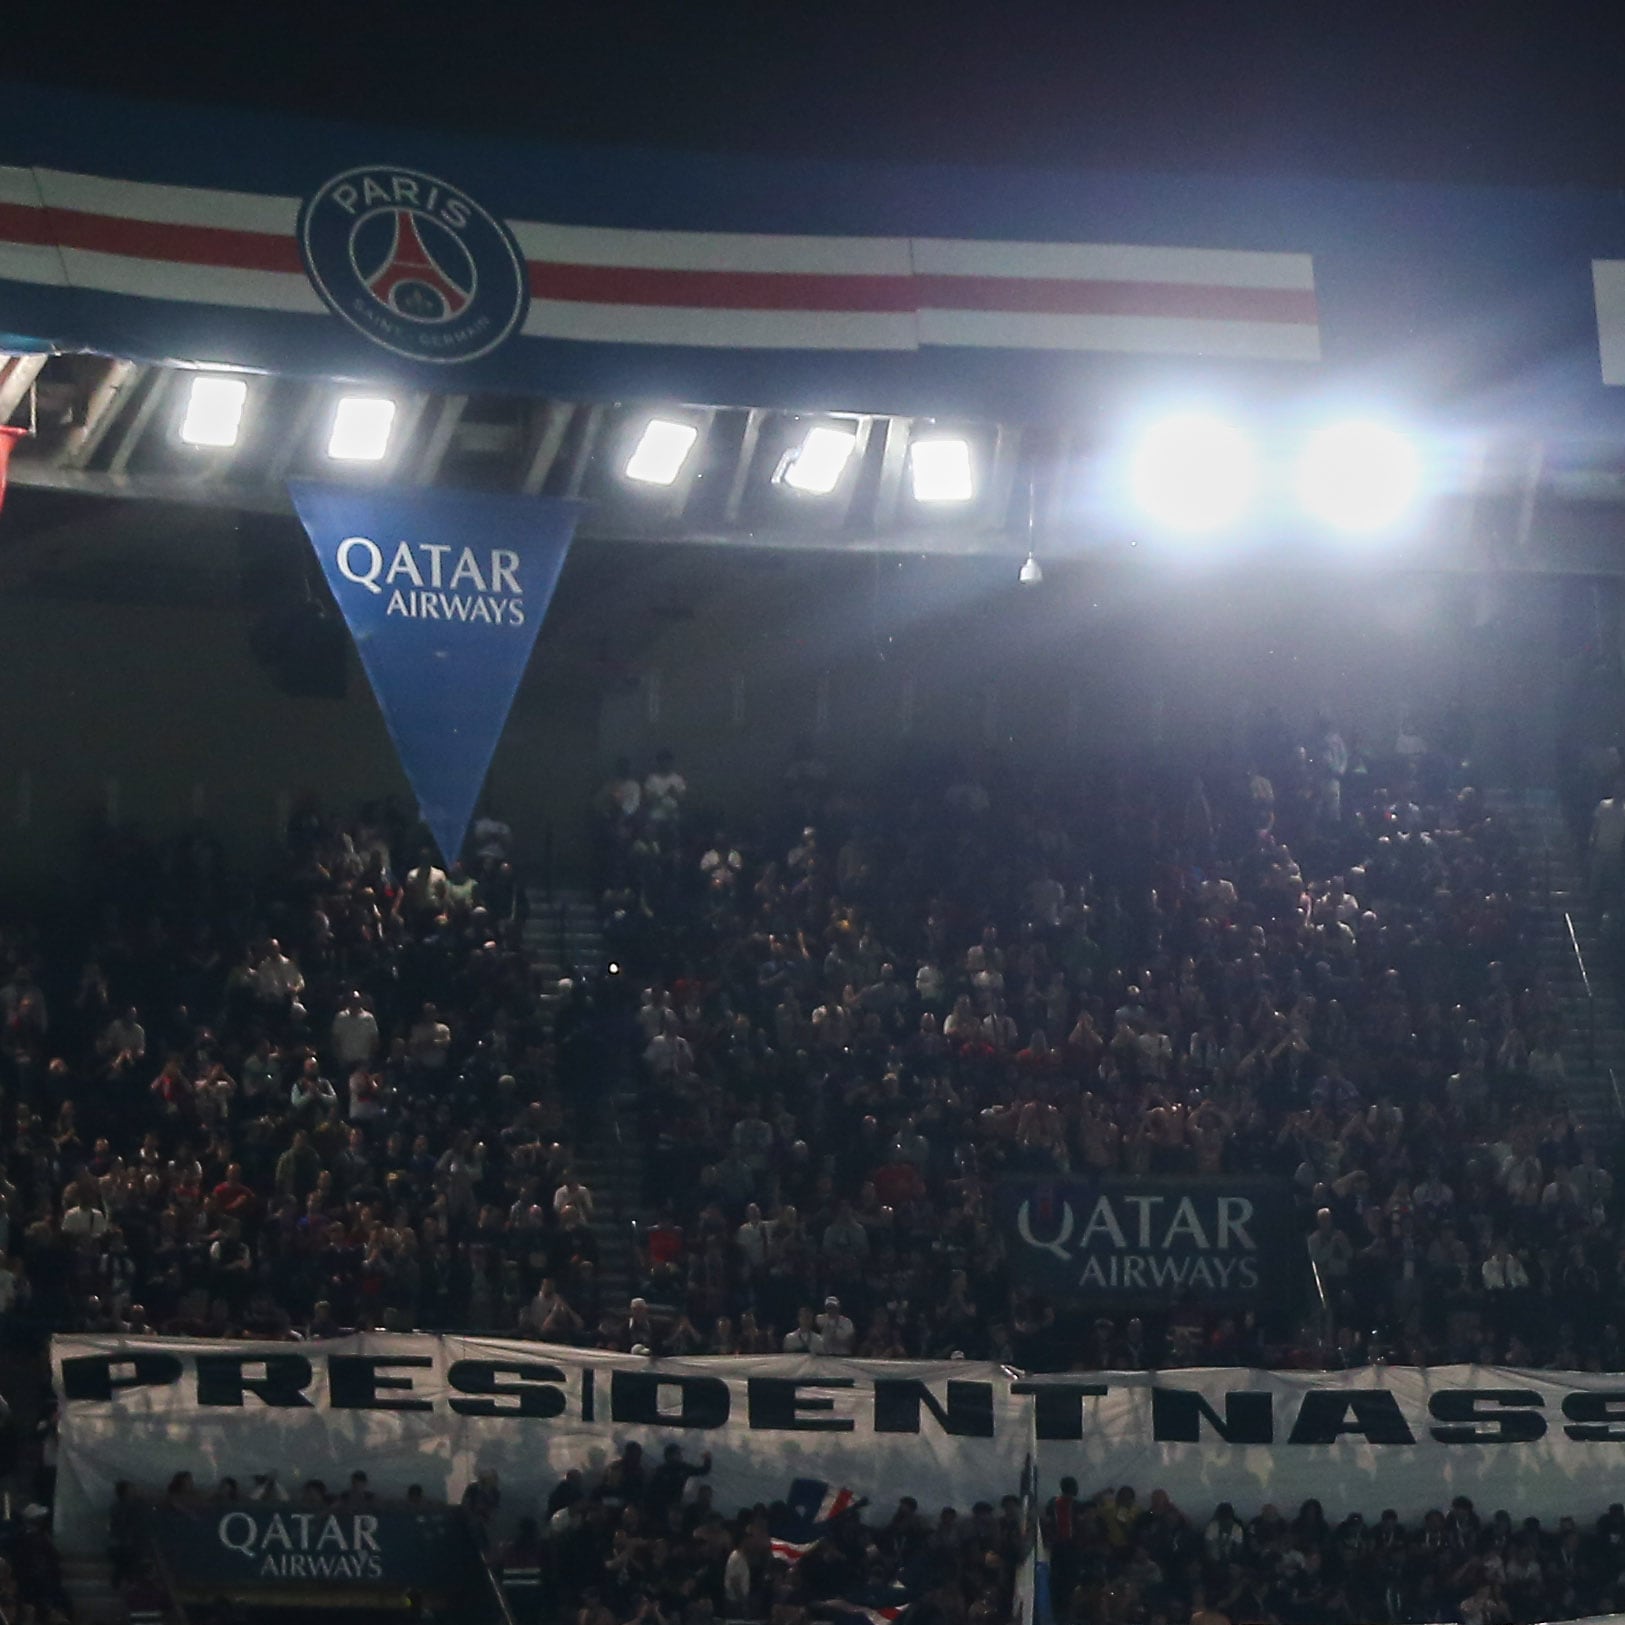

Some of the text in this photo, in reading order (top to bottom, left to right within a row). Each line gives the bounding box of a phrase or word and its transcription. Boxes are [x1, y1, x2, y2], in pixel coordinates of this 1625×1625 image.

[332, 177, 472, 229] PARIS
[336, 536, 524, 594] QATAR
[386, 589, 525, 625] AIRWAYS
[1016, 1195, 1257, 1261] QATAR
[1078, 1255, 1259, 1288] AIRWAYS
[217, 1511, 383, 1558] QATAR
[260, 1554, 383, 1579] AIRWAYS
